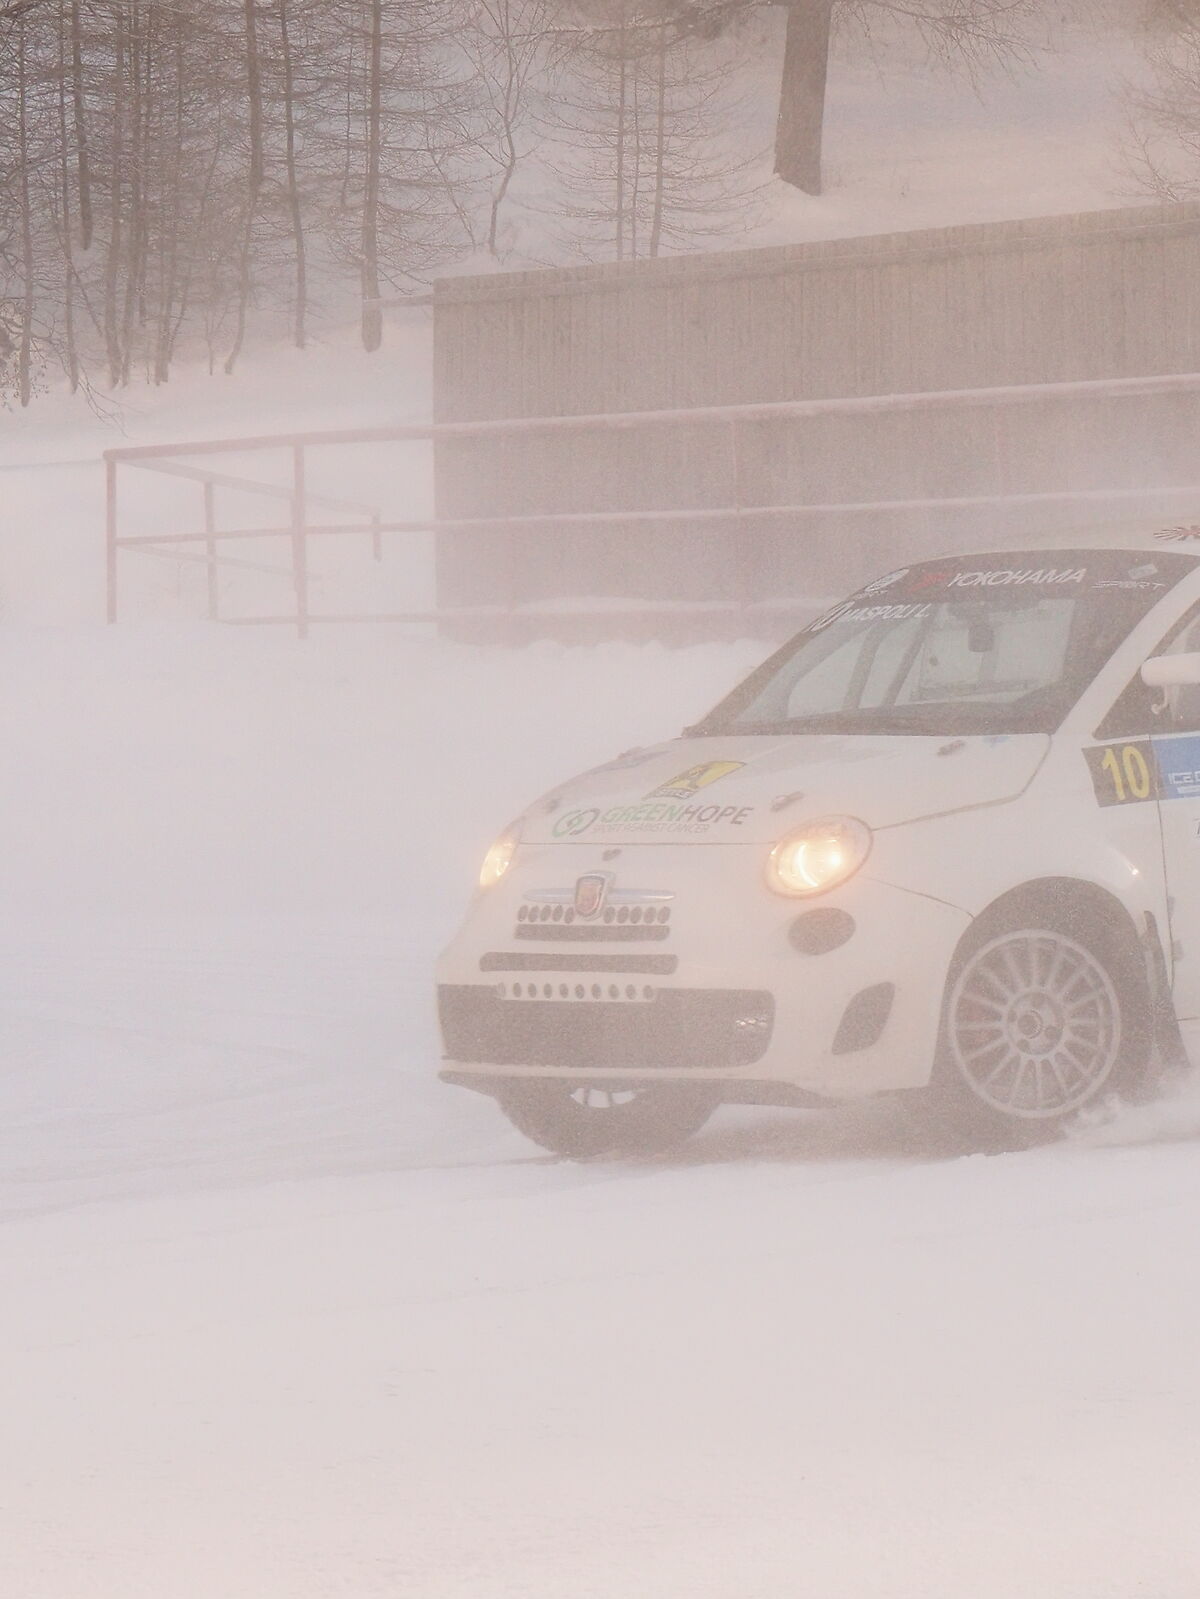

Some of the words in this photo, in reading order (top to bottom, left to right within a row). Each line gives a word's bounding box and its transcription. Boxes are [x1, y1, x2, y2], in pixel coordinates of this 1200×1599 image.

[947, 568, 1088, 588] YOKOHAMA
[1101, 745, 1150, 801] 10
[1168, 771, 1193, 785] ICE
